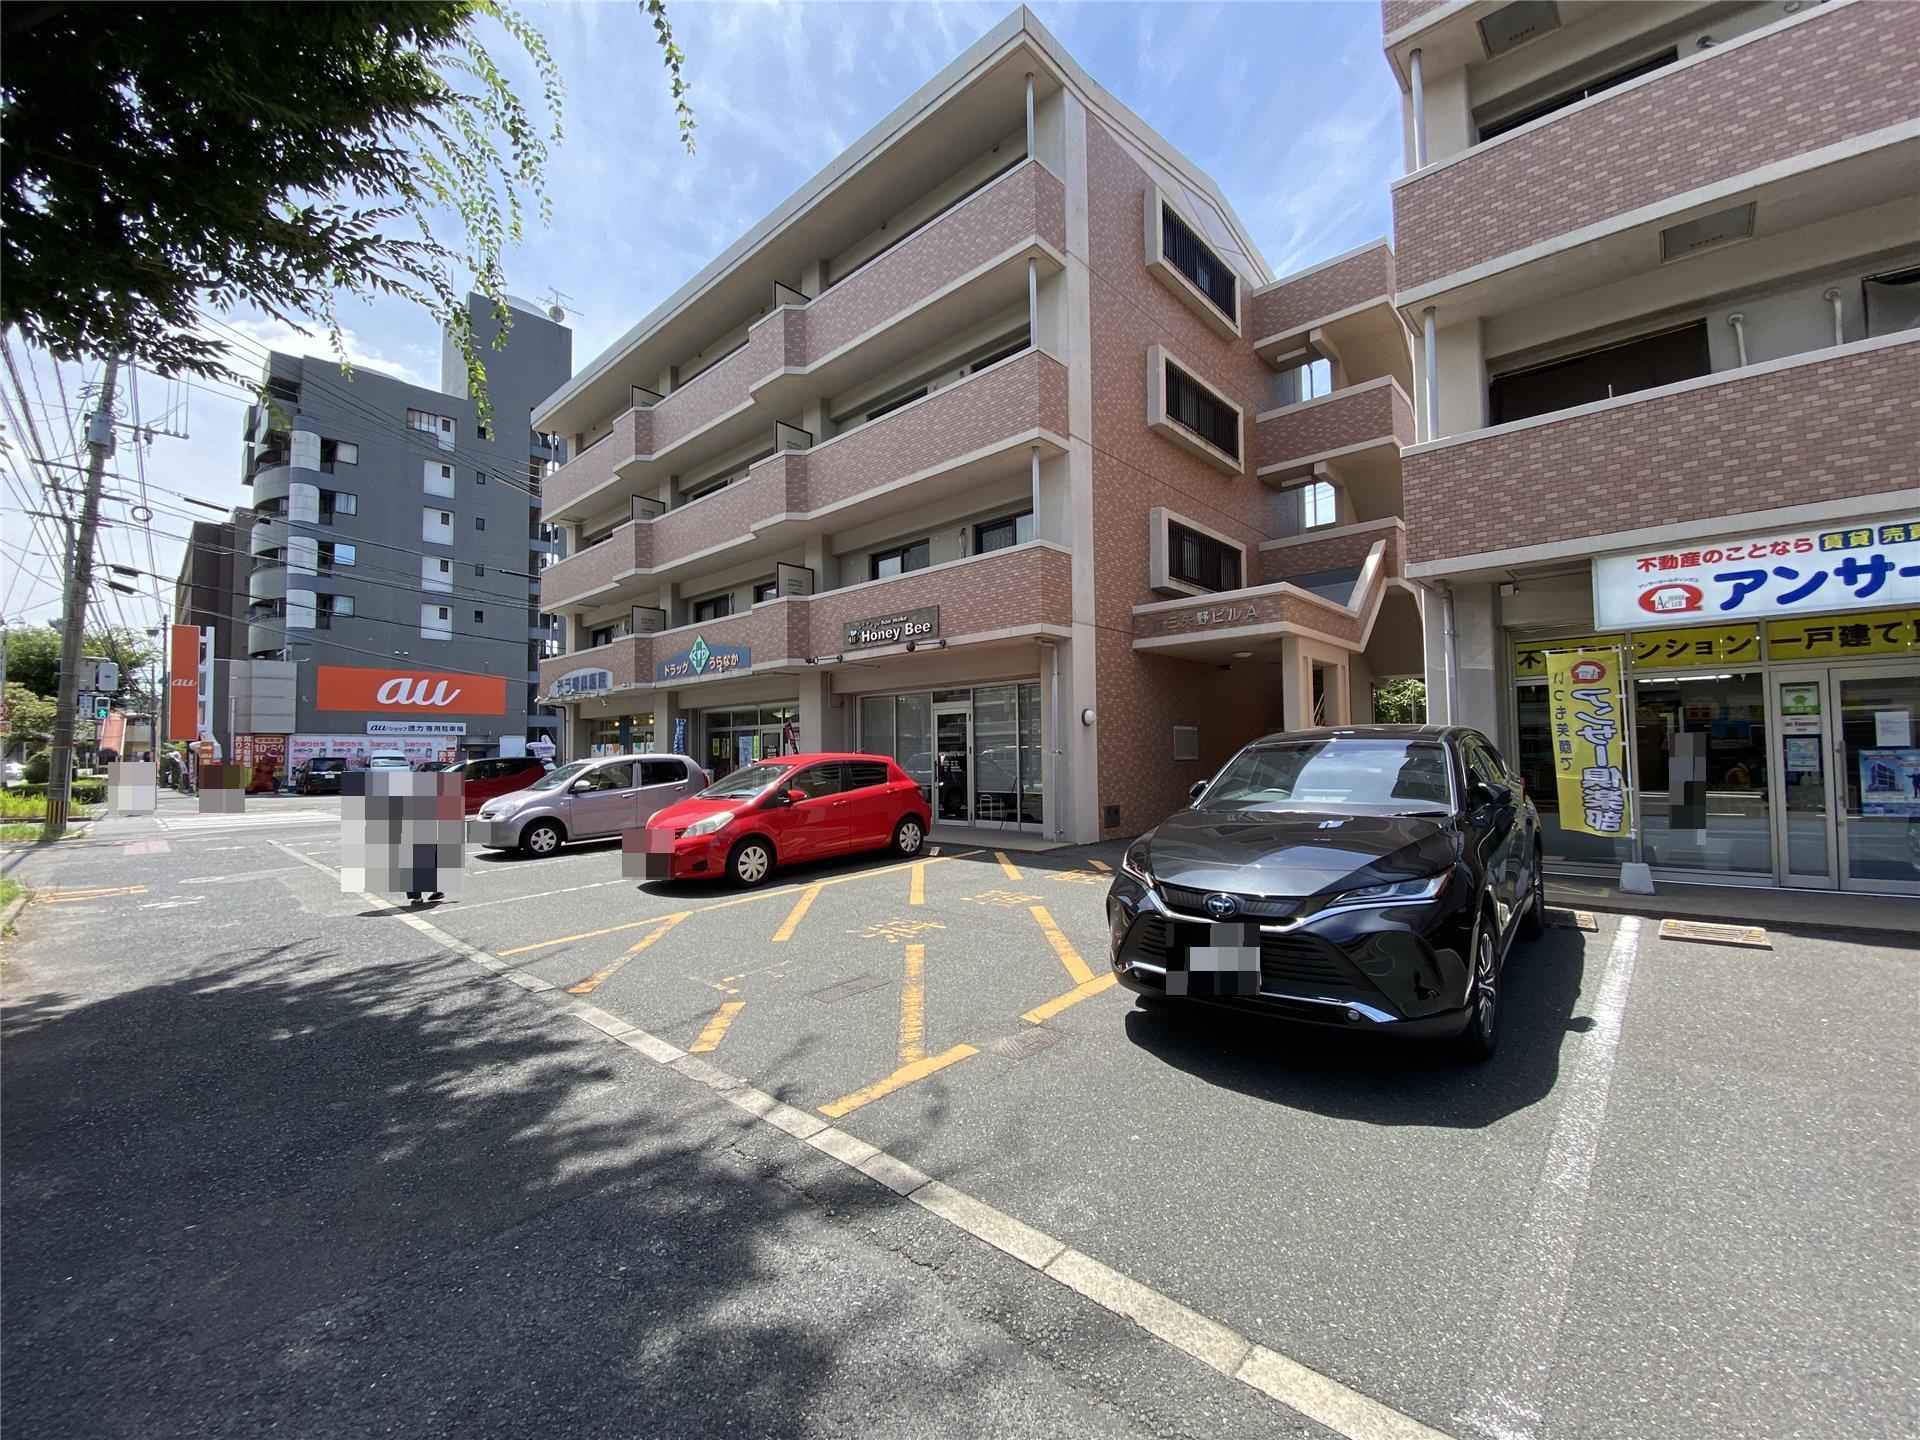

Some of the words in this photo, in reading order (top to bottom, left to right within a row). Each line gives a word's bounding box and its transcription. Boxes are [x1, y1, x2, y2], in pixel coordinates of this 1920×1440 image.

[1636, 537, 1814, 573] 不動産のことなら
[1822, 529, 1870, 550] 賃貸
[861, 627, 900, 643] Honey
[905, 622, 931, 635] Bee
[664, 661, 689, 676] ドラッグ
[709, 652, 739, 669] うらなか
[172, 678, 198, 687] au
[376, 677, 461, 706] au
